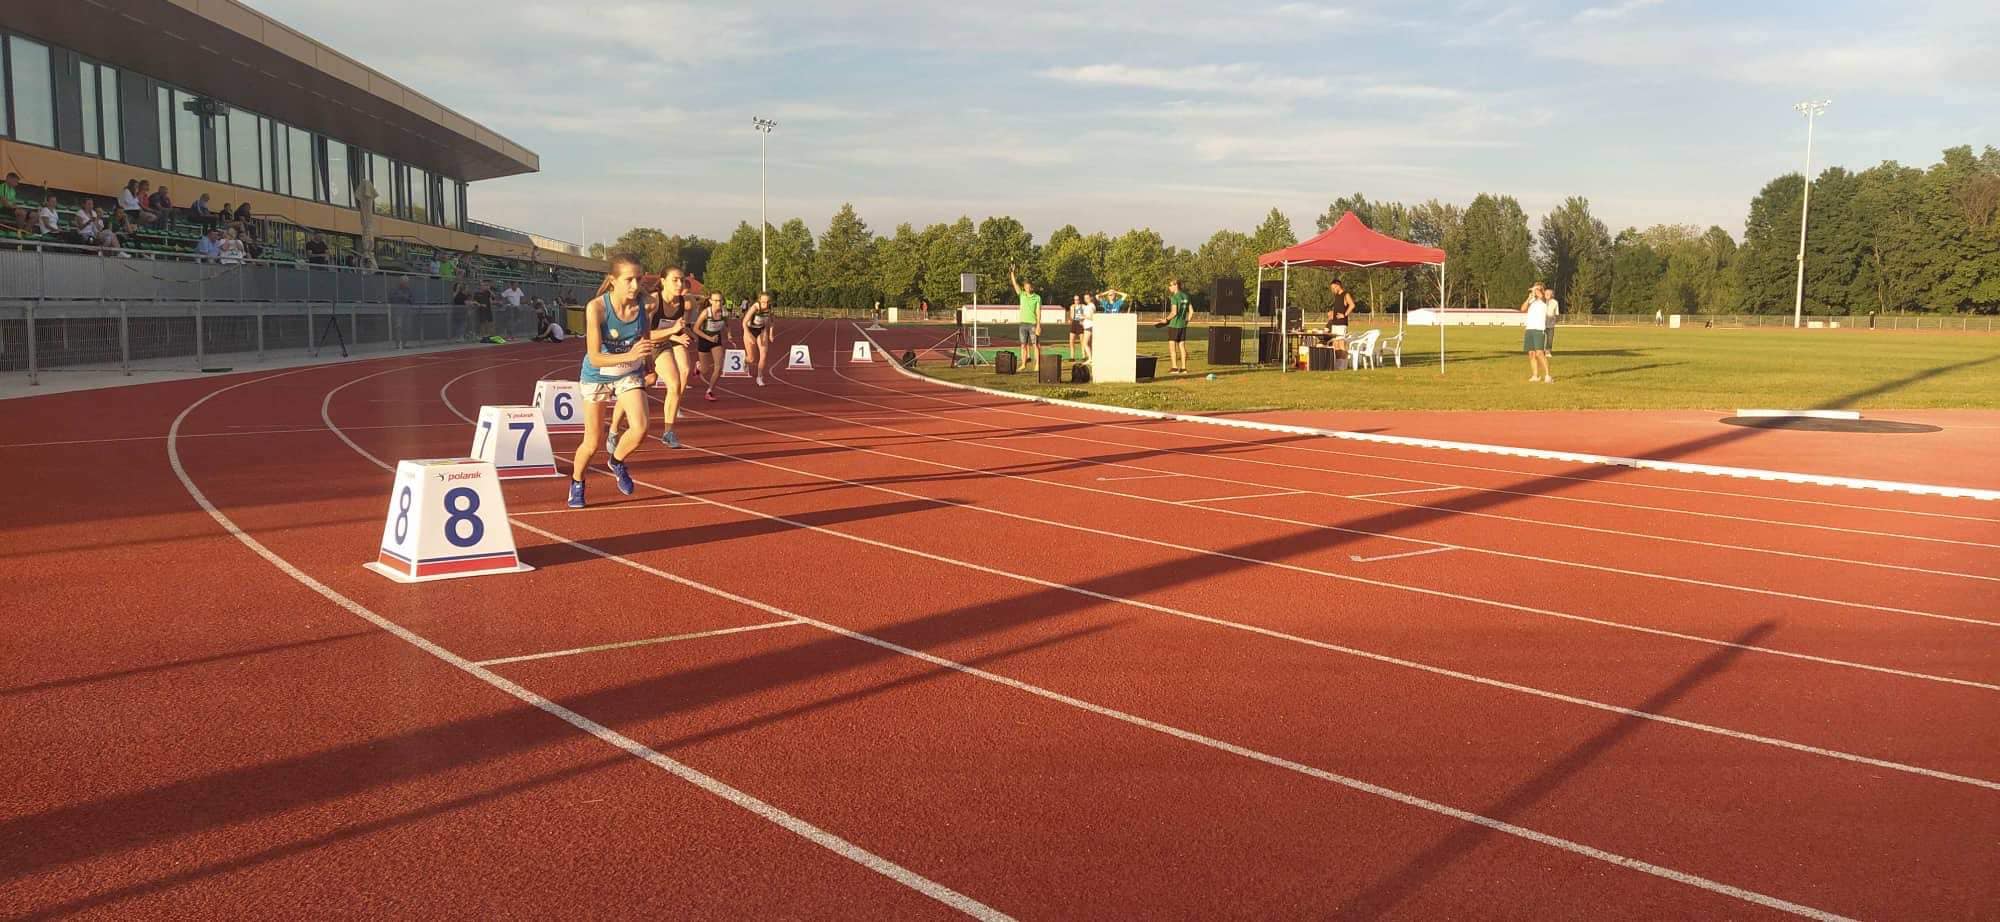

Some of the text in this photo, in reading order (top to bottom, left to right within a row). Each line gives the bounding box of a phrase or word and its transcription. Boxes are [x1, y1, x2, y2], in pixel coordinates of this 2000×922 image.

[731, 355, 742, 371] 3
[796, 350, 805, 364] 2
[858, 346, 865, 358] 1
[554, 392, 574, 421] 6
[479, 420, 492, 459] 7
[508, 422, 535, 461] 7
[395, 485, 412, 545] 8
[443, 486, 485, 548] 8
